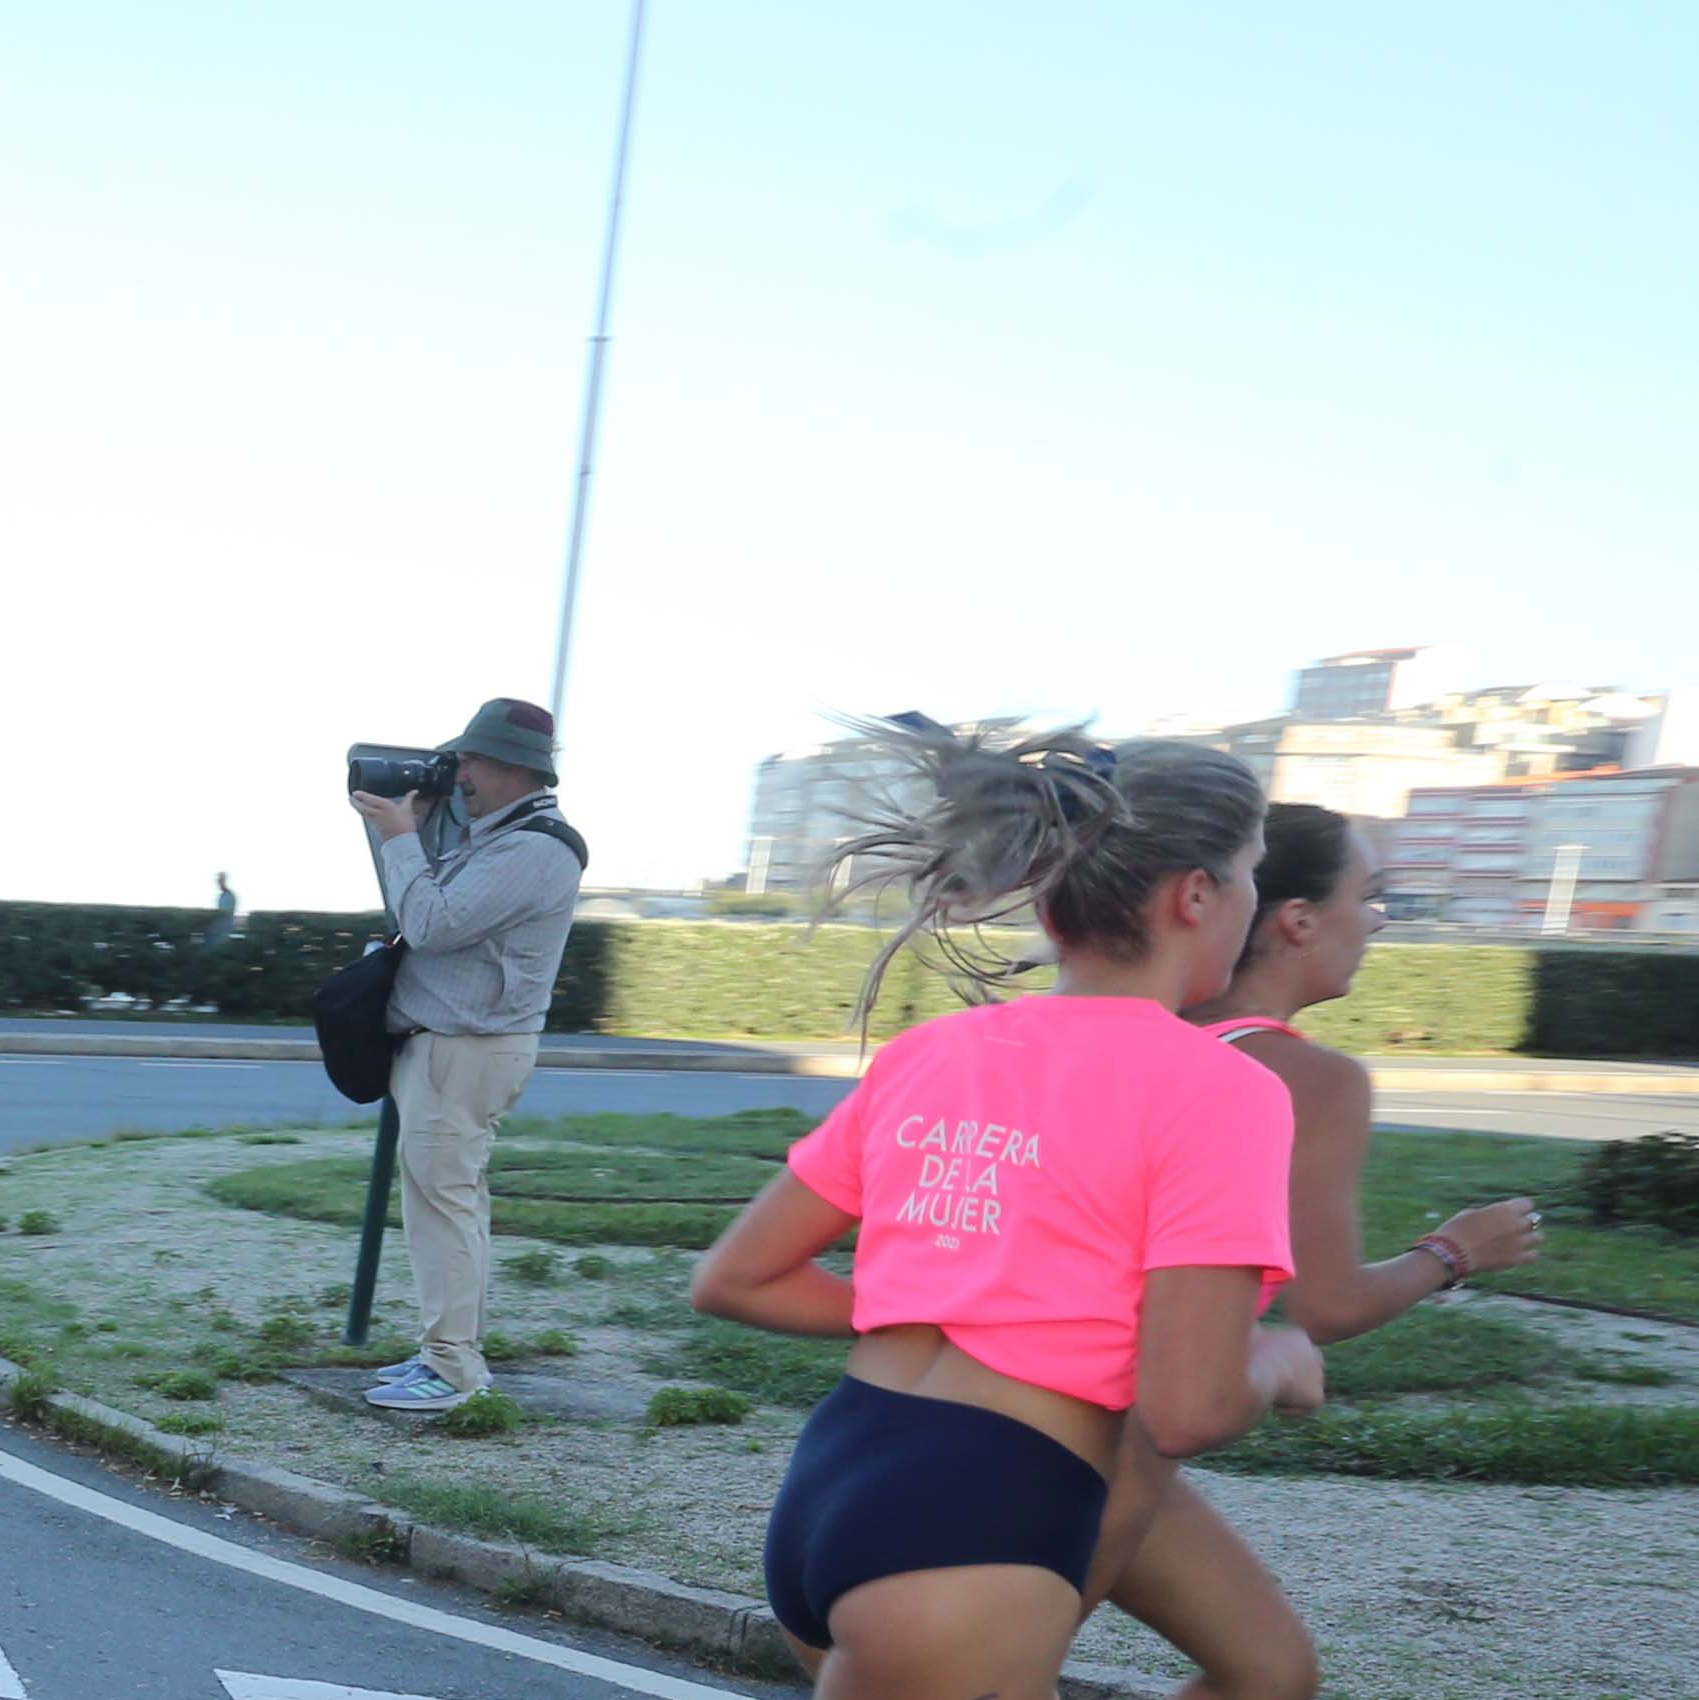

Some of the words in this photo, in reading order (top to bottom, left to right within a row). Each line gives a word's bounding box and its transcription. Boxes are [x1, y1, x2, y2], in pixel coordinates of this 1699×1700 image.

[896, 1114, 1041, 1169] CARRERA
[919, 1154, 963, 1190] DE
[896, 1189, 1002, 1236] MUJER
